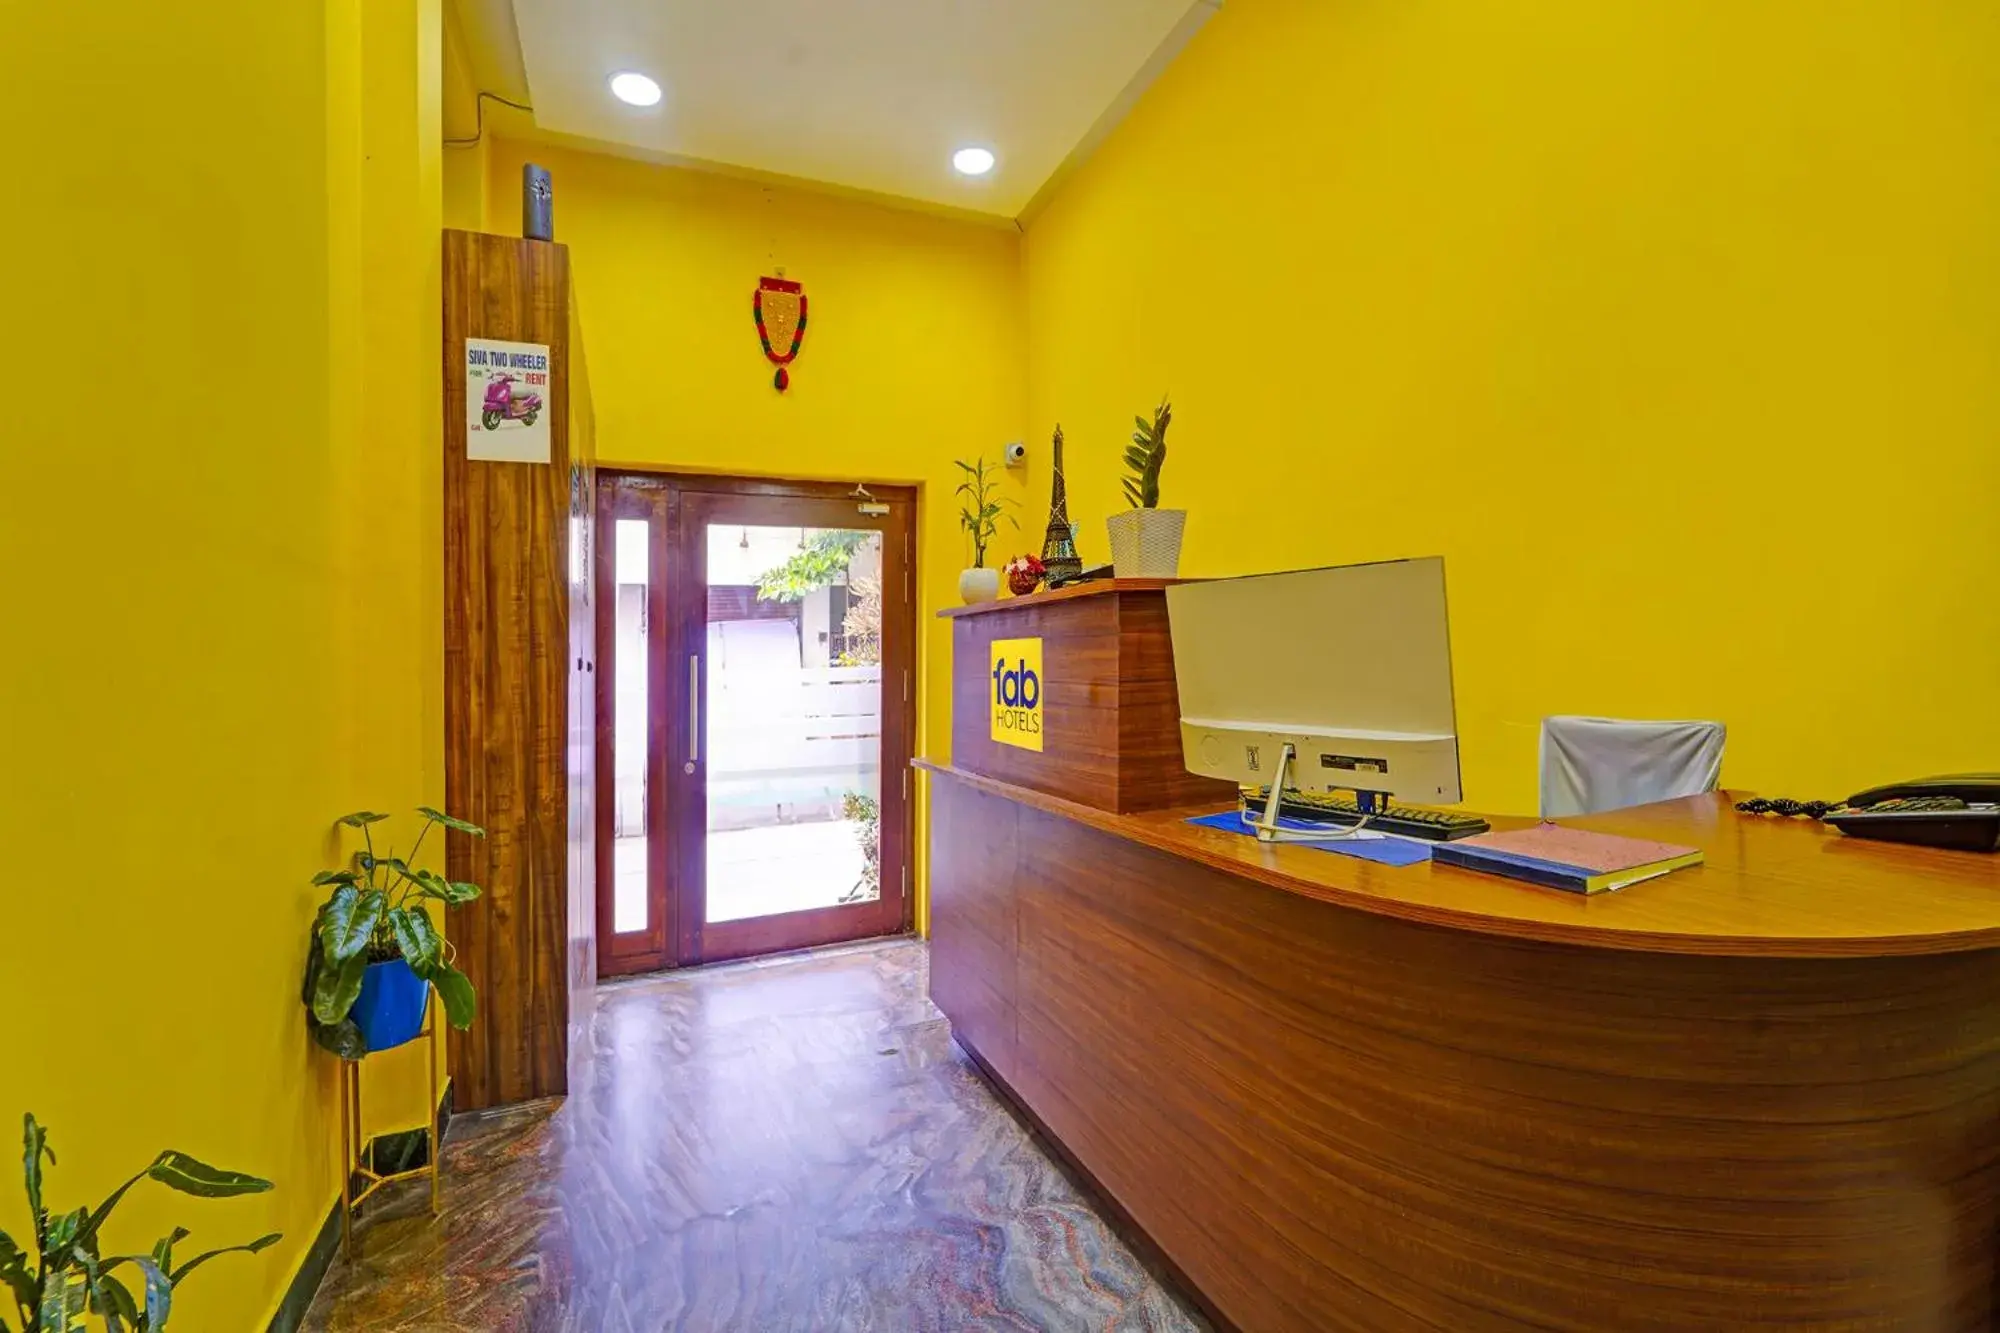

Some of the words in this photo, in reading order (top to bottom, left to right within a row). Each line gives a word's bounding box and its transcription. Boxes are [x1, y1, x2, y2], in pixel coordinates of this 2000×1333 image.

[468, 349, 488, 366] SIVA
[490, 351, 507, 367] TWO
[509, 353, 547, 370] WHEELER
[525, 373, 546, 385] RENT
[993, 658, 1039, 709] fab
[996, 709, 1039, 733] HOTELS
